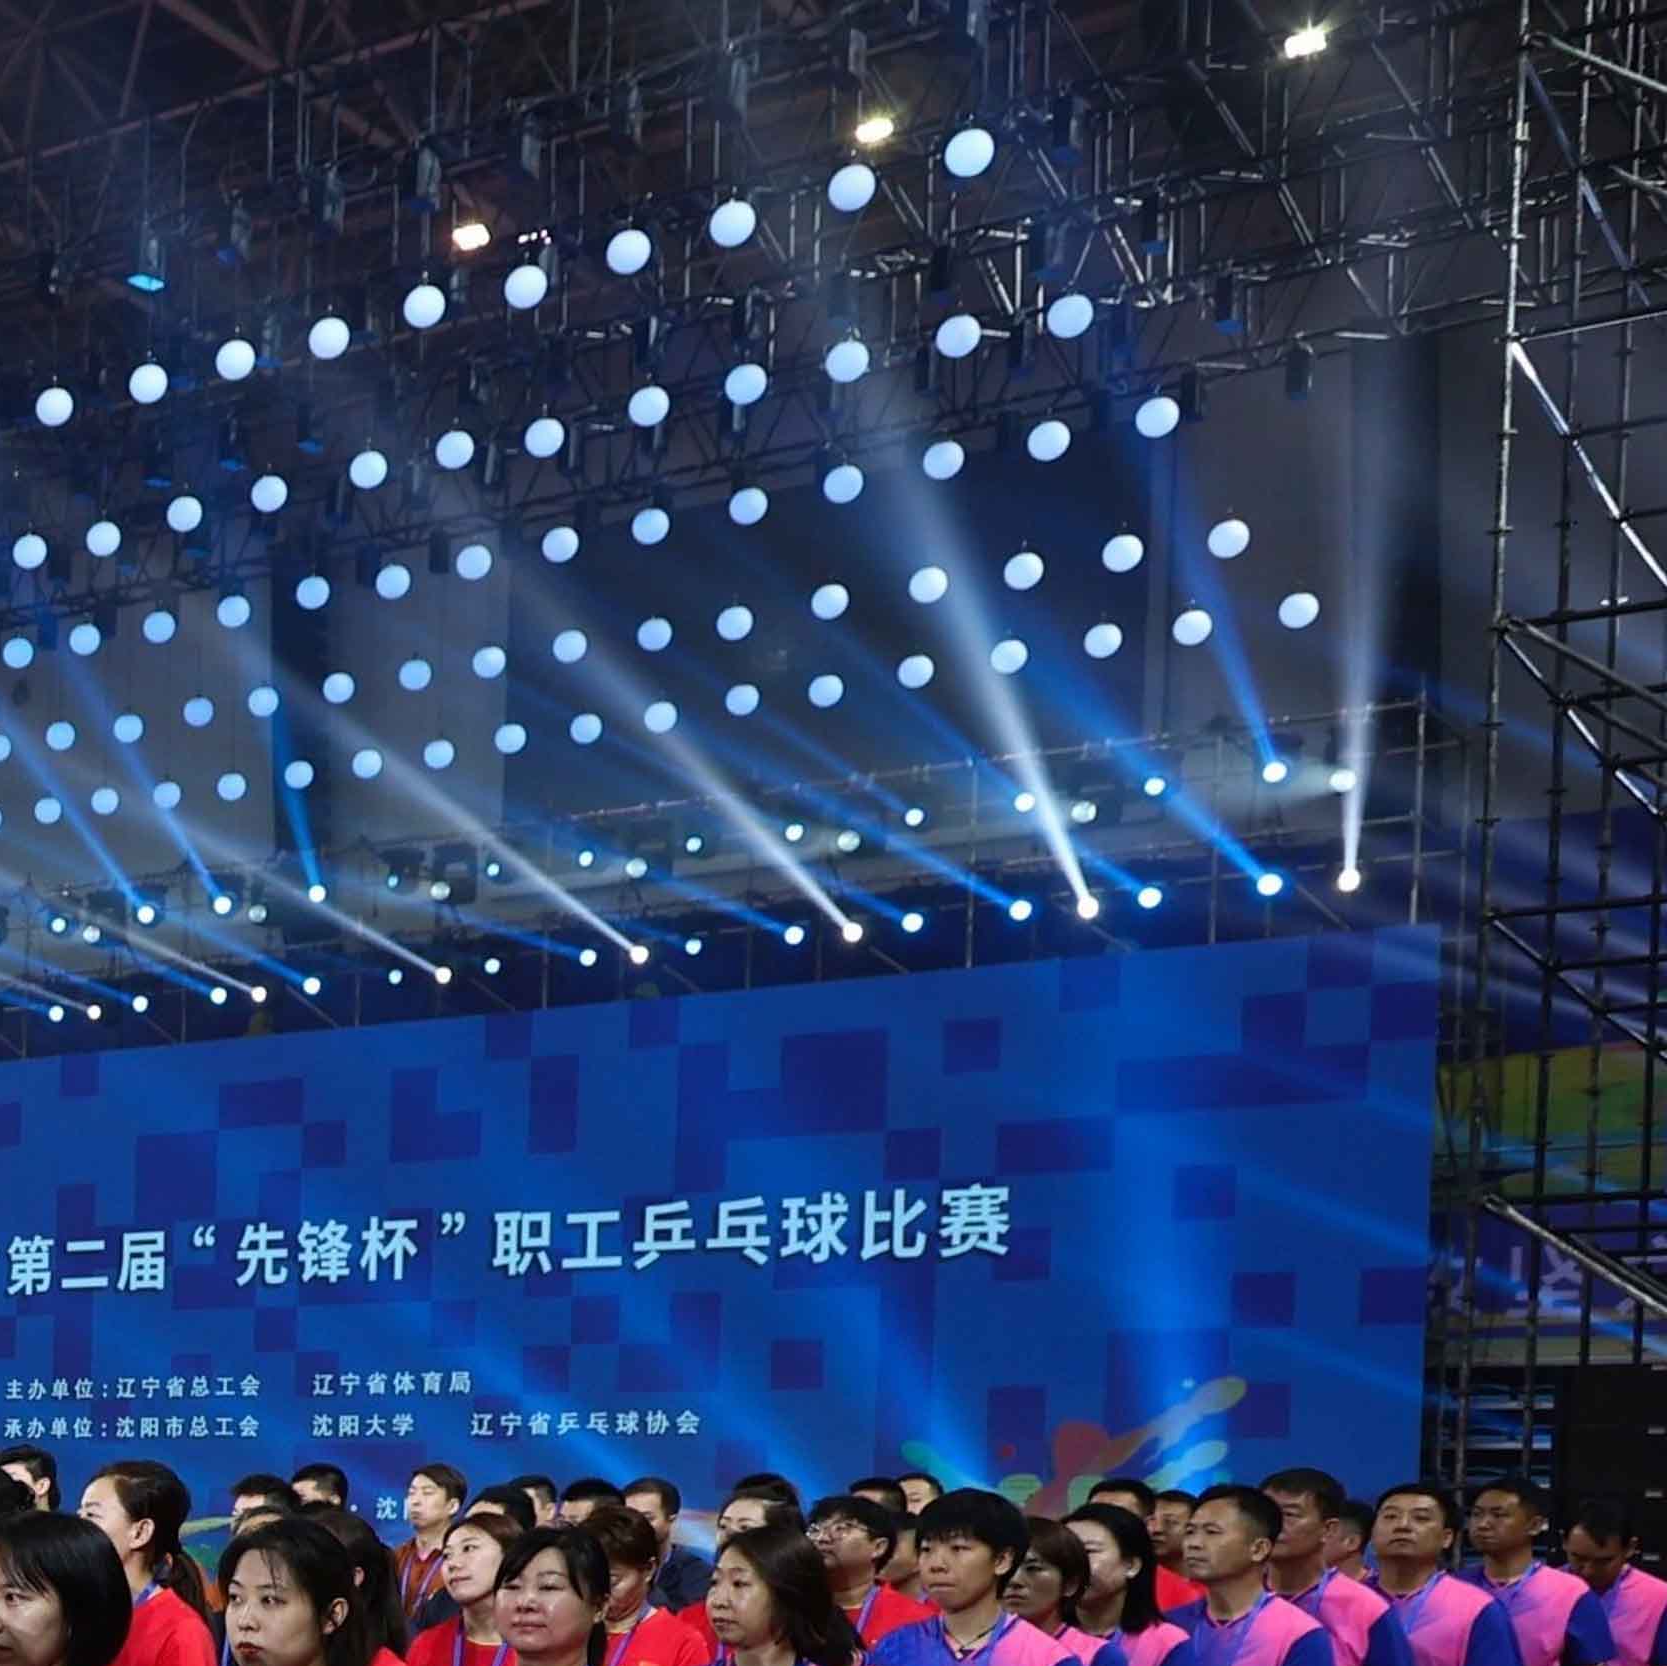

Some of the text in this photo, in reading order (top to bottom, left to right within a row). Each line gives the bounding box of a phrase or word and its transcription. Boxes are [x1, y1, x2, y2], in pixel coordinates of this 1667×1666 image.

[312, 1371, 472, 1396] 辽宁省体育局
[312, 1413, 415, 1437] 沈阳大学
[470, 1409, 701, 1437] 辽宁省乒乓球协会
